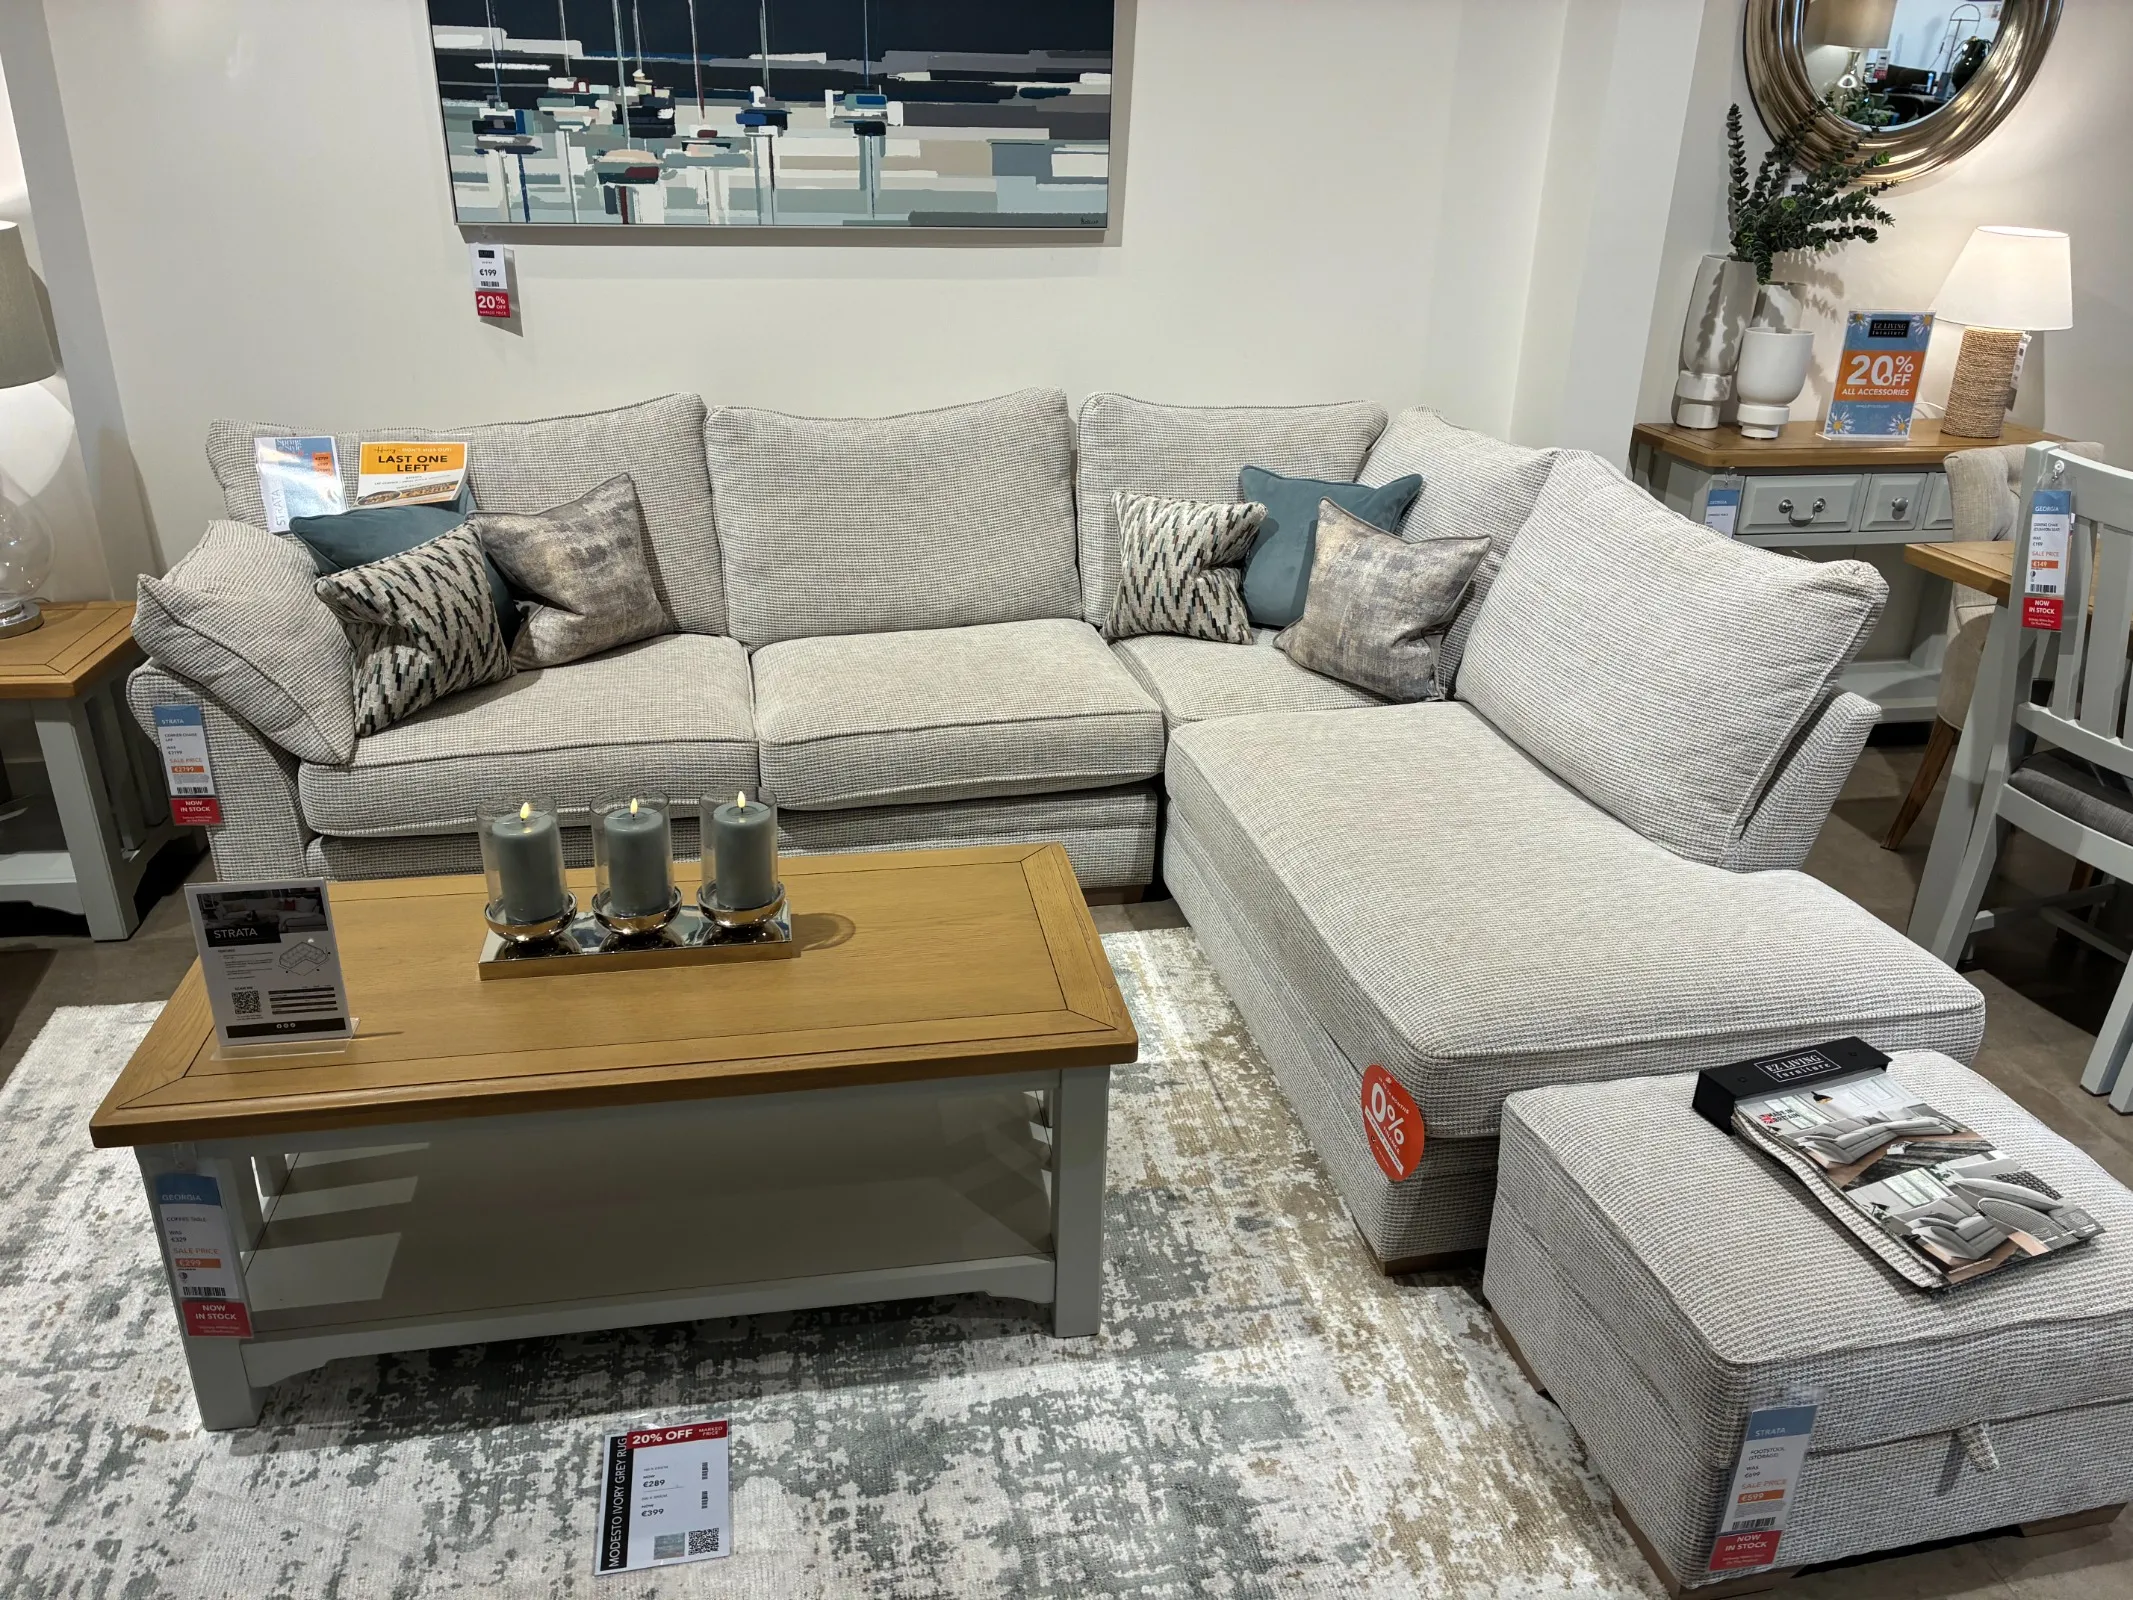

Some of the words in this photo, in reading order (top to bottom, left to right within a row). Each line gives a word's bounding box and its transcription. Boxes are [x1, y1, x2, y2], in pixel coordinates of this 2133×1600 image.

[478, 295, 506, 309] 20%
[1847, 355, 1914, 386] 20%
[1880, 373, 1912, 386] OFF
[1842, 388, 1856, 396] ALL
[1858, 388, 1910, 396] ACCESSORIES
[378, 455, 413, 463] LAST
[417, 455, 448, 463] ONE
[397, 464, 430, 472] LEFT
[213, 927, 258, 939] STRATA
[1764, 1063, 1782, 1073] EZ
[1784, 1054, 1822, 1069] LIVING
[1776, 1062, 1831, 1079] furniture
[1371, 1082, 1405, 1145] 0%
[632, 1433, 663, 1445] 20%
[665, 1428, 693, 1440] OFF
[1755, 1427, 1786, 1437] STRATA
[616, 1437, 628, 1458] RUG
[614, 1459, 626, 1484] GREY
[643, 1479, 666, 1488] €289
[1742, 1481, 1763, 1489] SALE
[1763, 1479, 1787, 1487] PRICE
[612, 1485, 625, 1515] IVORY
[1742, 1492, 1765, 1501] €599
[641, 1508, 664, 1517] €399
[608, 1516, 623, 1567] MODESTO
[1736, 1534, 1762, 1542] NOW
[1737, 1541, 1768, 1550] STOCK
